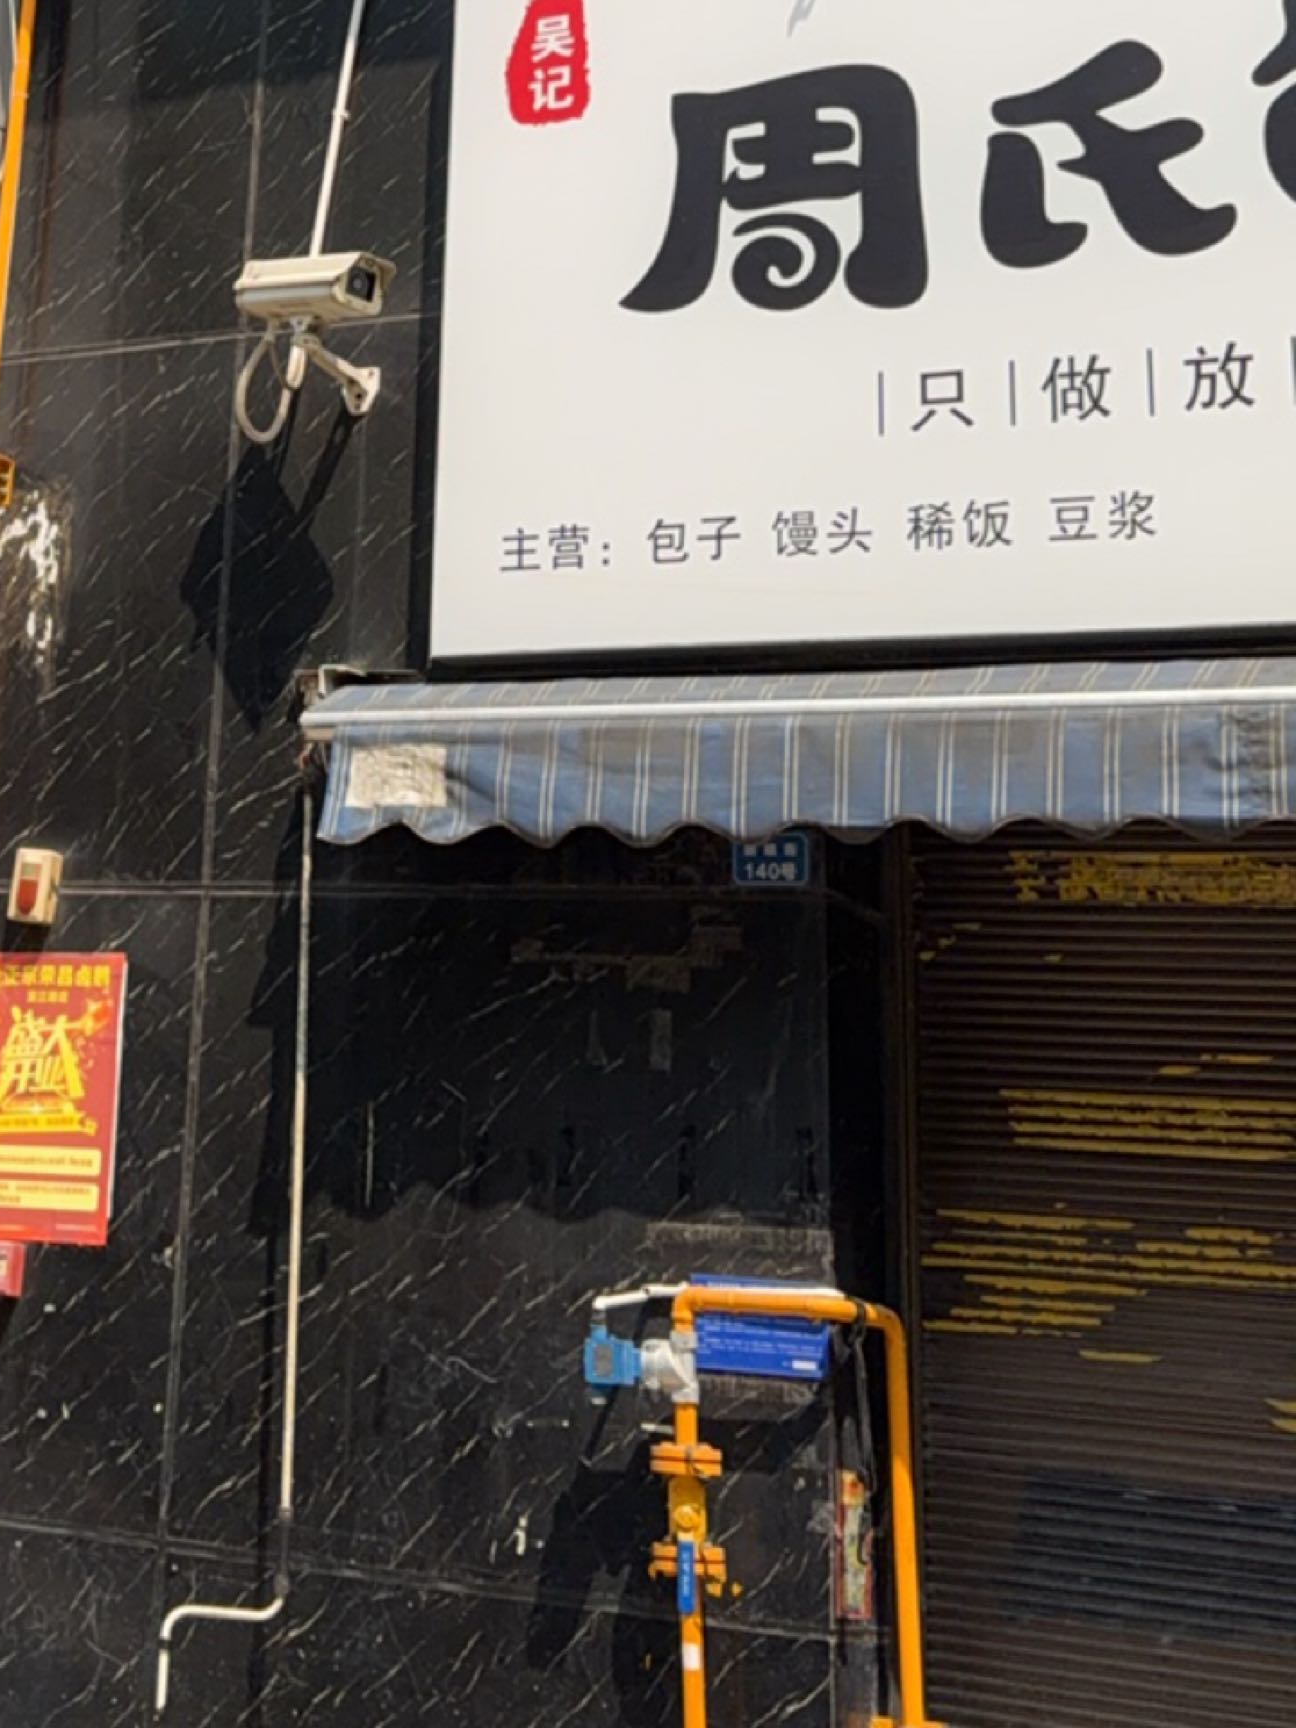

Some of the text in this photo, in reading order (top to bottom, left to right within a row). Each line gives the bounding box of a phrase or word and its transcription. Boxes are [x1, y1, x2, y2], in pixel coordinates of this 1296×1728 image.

[527, 15, 576, 114] 吴记
[647, 515, 741, 566] 包子
[771, 507, 873, 557] 馒头
[906, 498, 1013, 552] 稀饭
[1048, 489, 1157, 543] 豆浆
